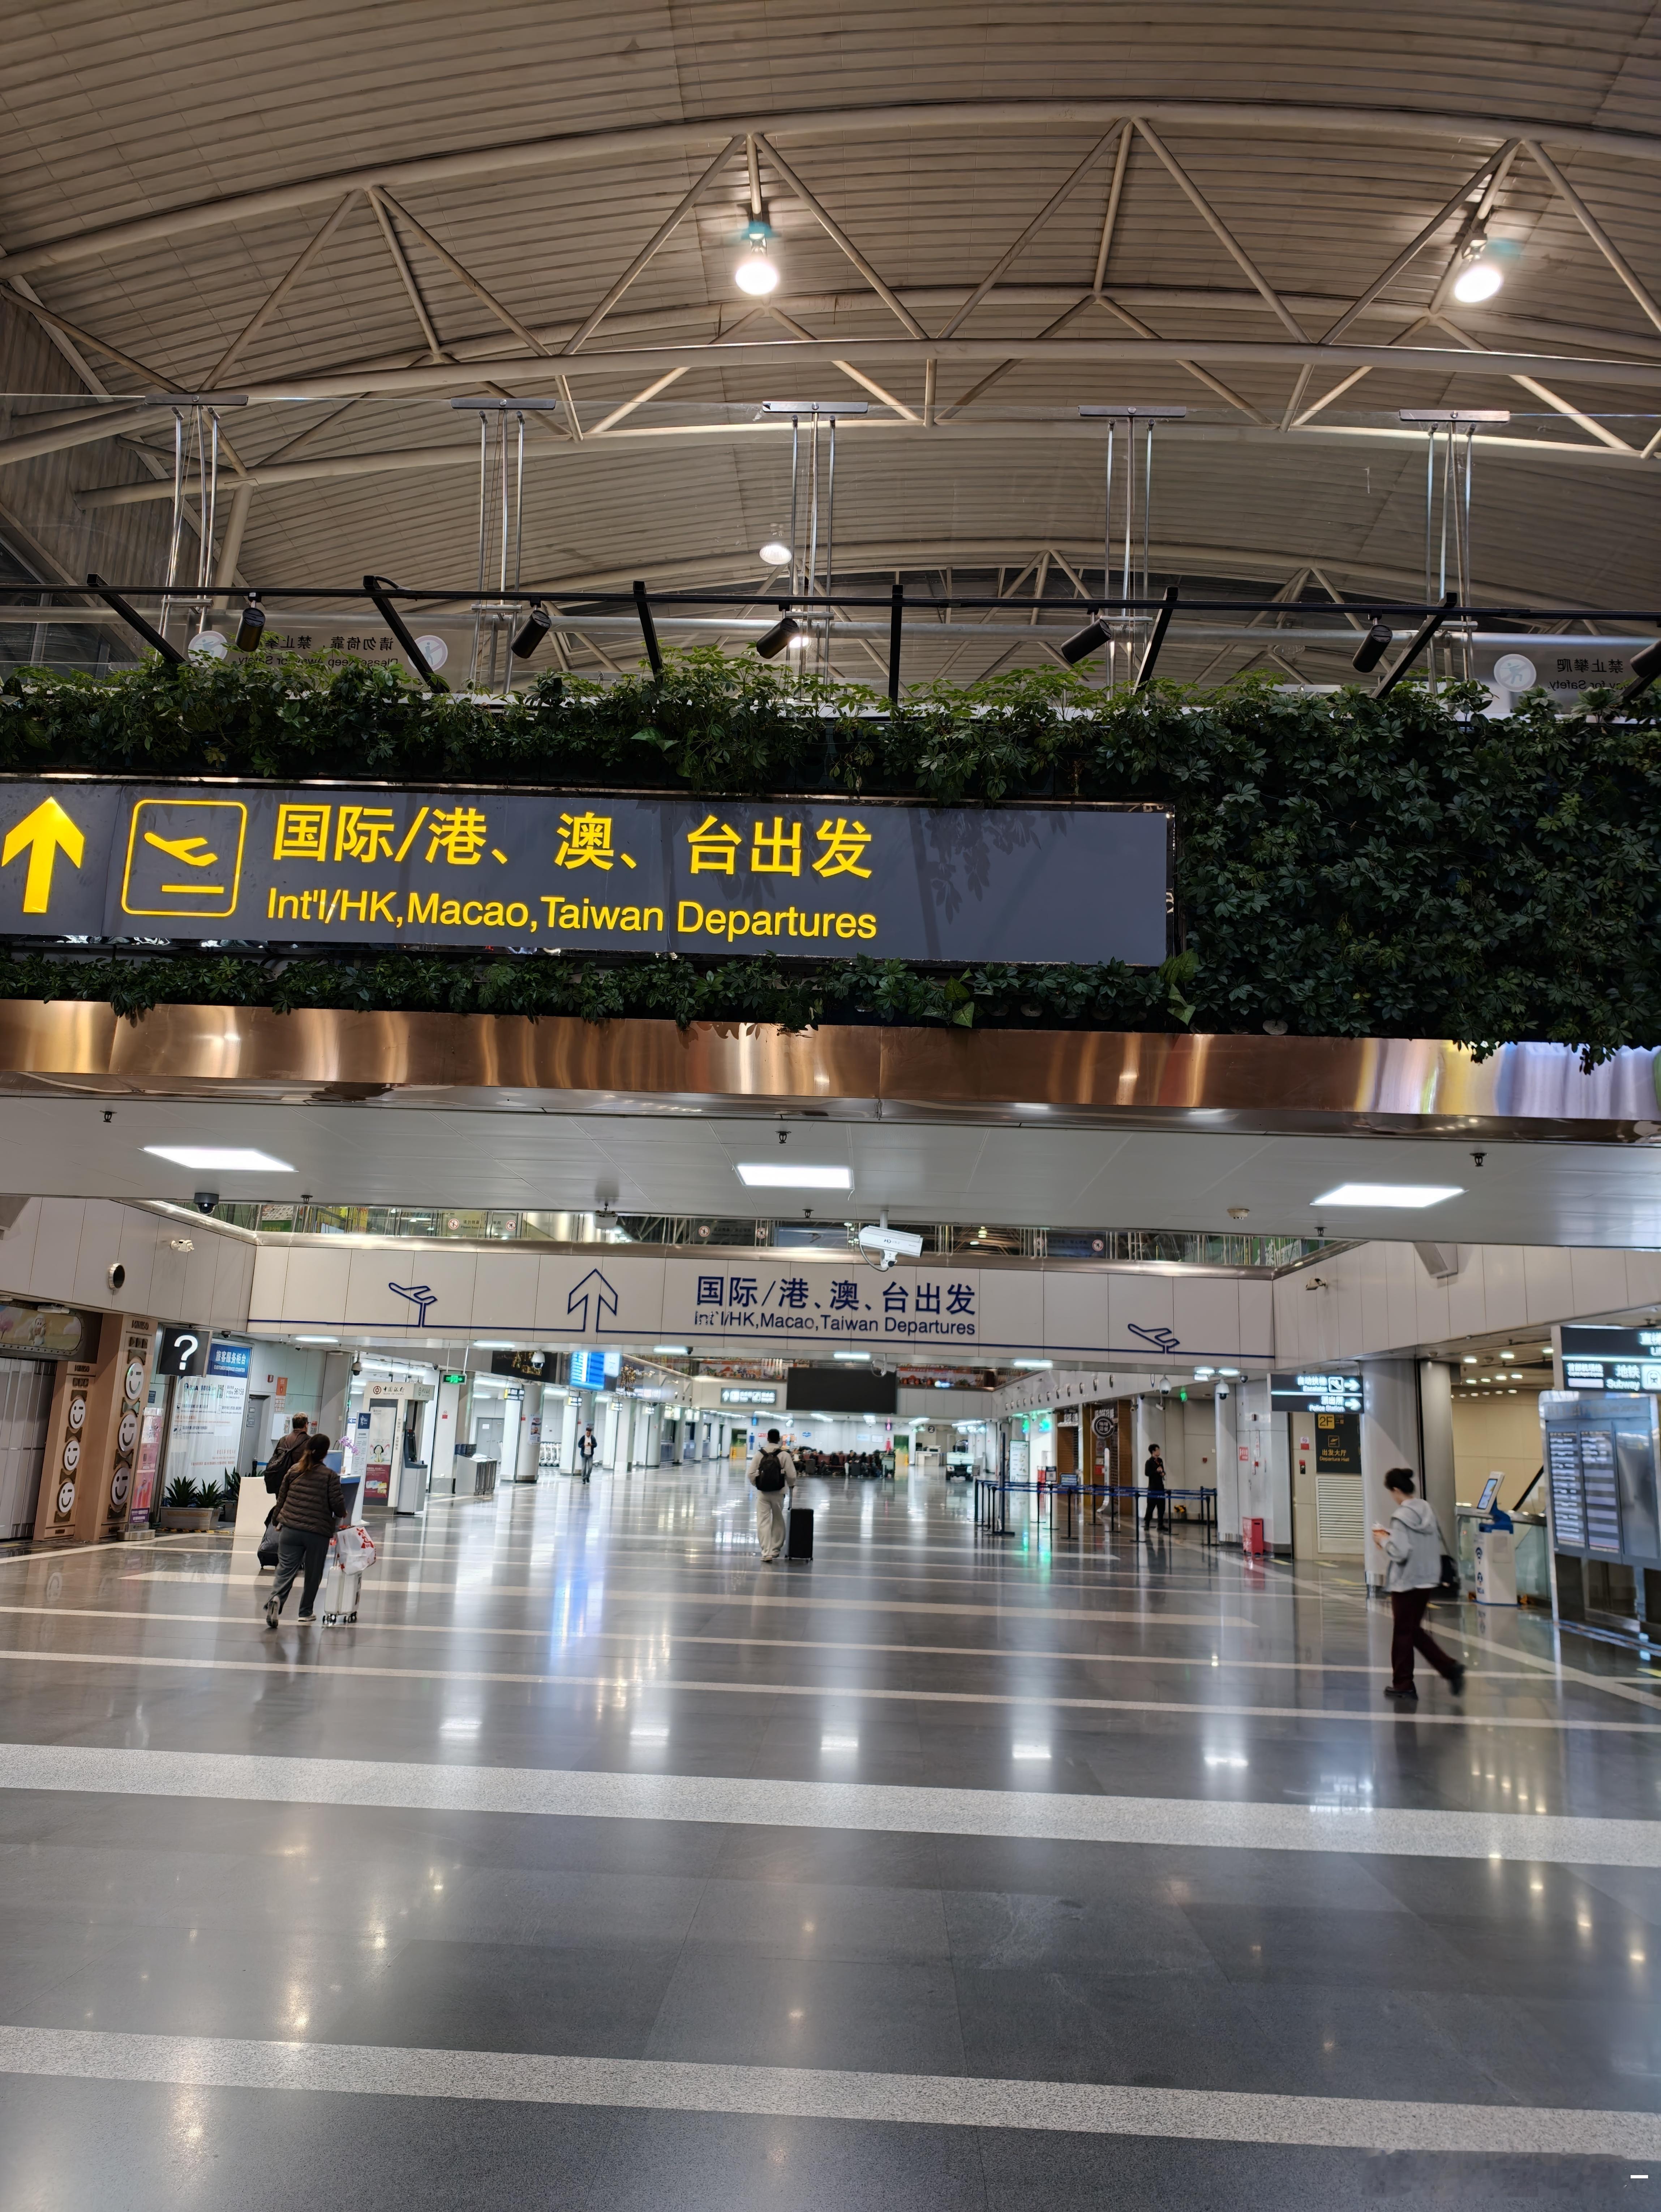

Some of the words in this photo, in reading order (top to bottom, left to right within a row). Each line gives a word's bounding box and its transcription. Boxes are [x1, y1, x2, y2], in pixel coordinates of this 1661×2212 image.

[678, 901, 876, 941] Departures
[697, 1276, 975, 1315] 国际/港、澳、台出发
[132, 1320, 149, 1330] MINISO
[885, 1317, 975, 1336] Departures
[215, 1350, 246, 1365] 旅客服务柜台
[1615, 1364, 1640, 1379] 地铁
[1297, 1376, 1328, 1386] 自动扶梯
[1606, 1379, 1640, 1392] Subway
[1321, 1396, 1345, 1406] 派出所
[1319, 1416, 1333, 1426] 2F
